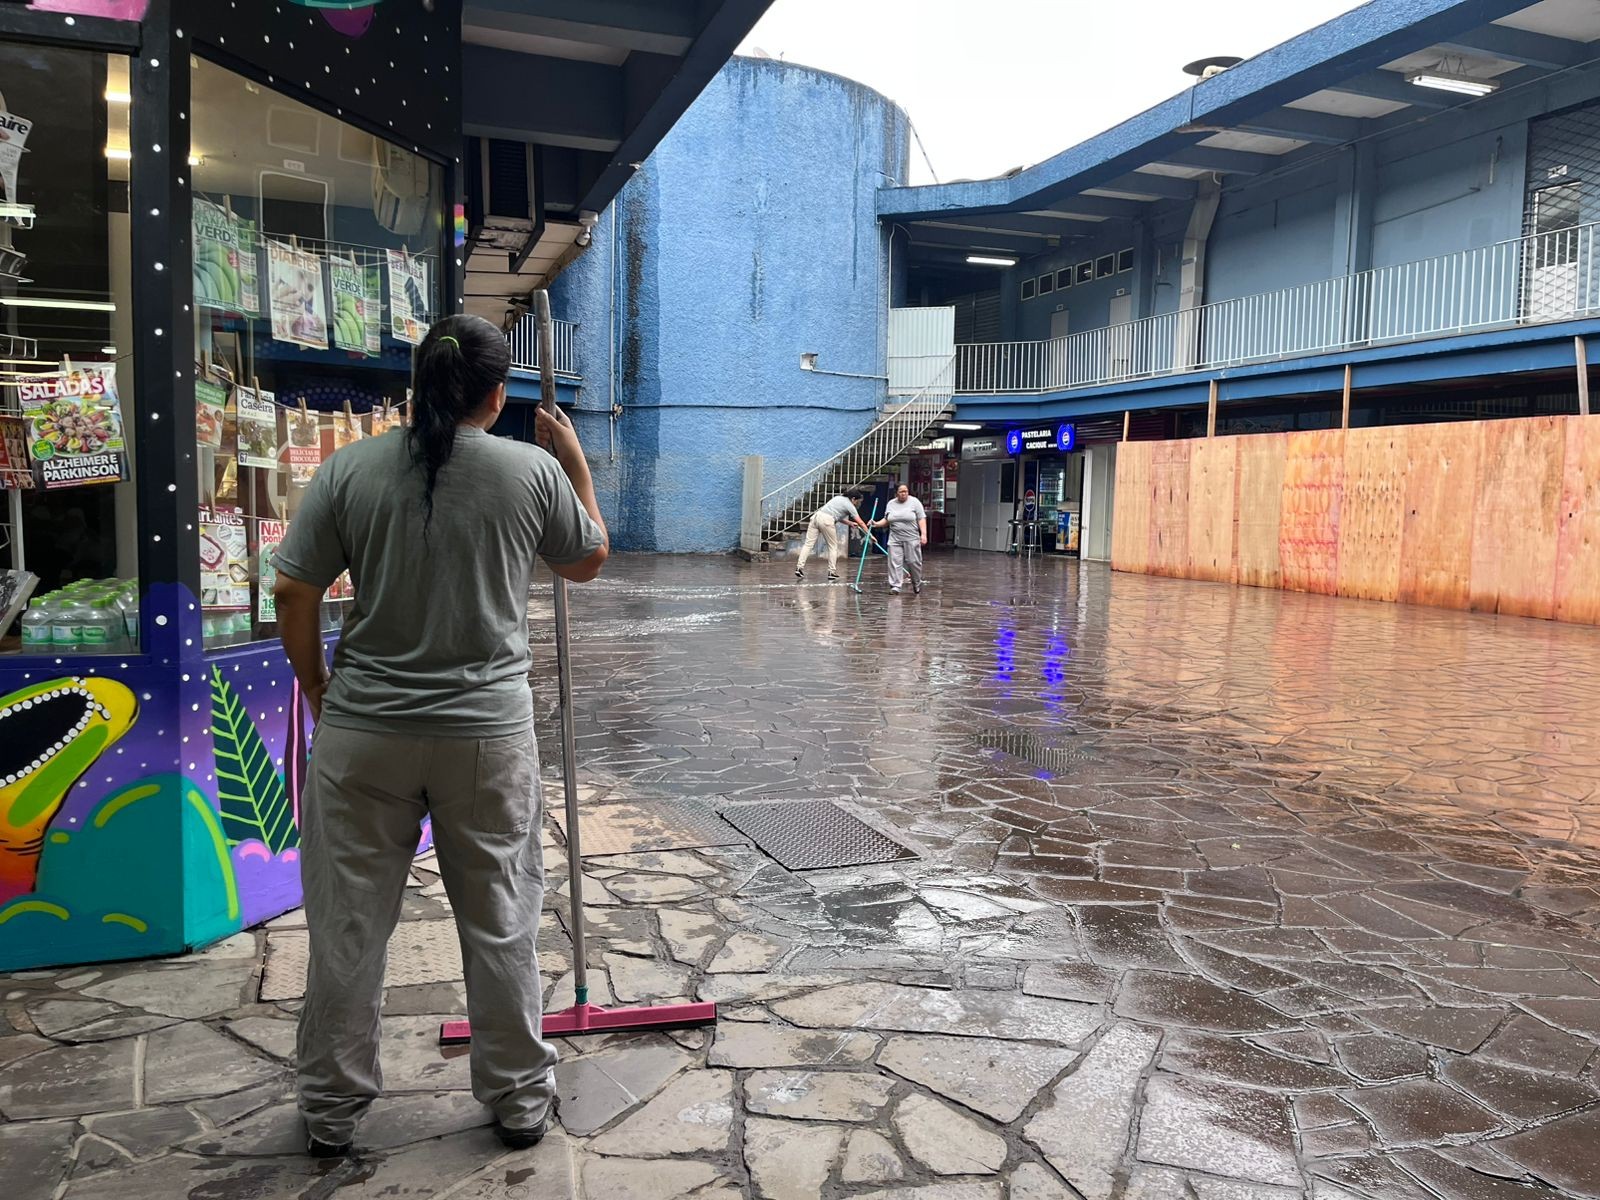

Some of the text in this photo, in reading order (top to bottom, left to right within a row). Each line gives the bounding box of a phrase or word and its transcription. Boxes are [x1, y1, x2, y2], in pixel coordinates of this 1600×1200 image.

[195, 222, 238, 246] VERDE
[271, 246, 319, 273] DIABETES
[333, 278, 361, 295] VERDE
[21, 377, 104, 400] SALADAS
[241, 399, 273, 413] Caseira
[1021, 430, 1051, 439] PASTELARIA
[1026, 441, 1047, 449] CACIQUE
[43, 454, 117, 470] ALZHEIMER E
[240, 453, 247, 463] 67
[43, 464, 120, 480] PARKINSON
